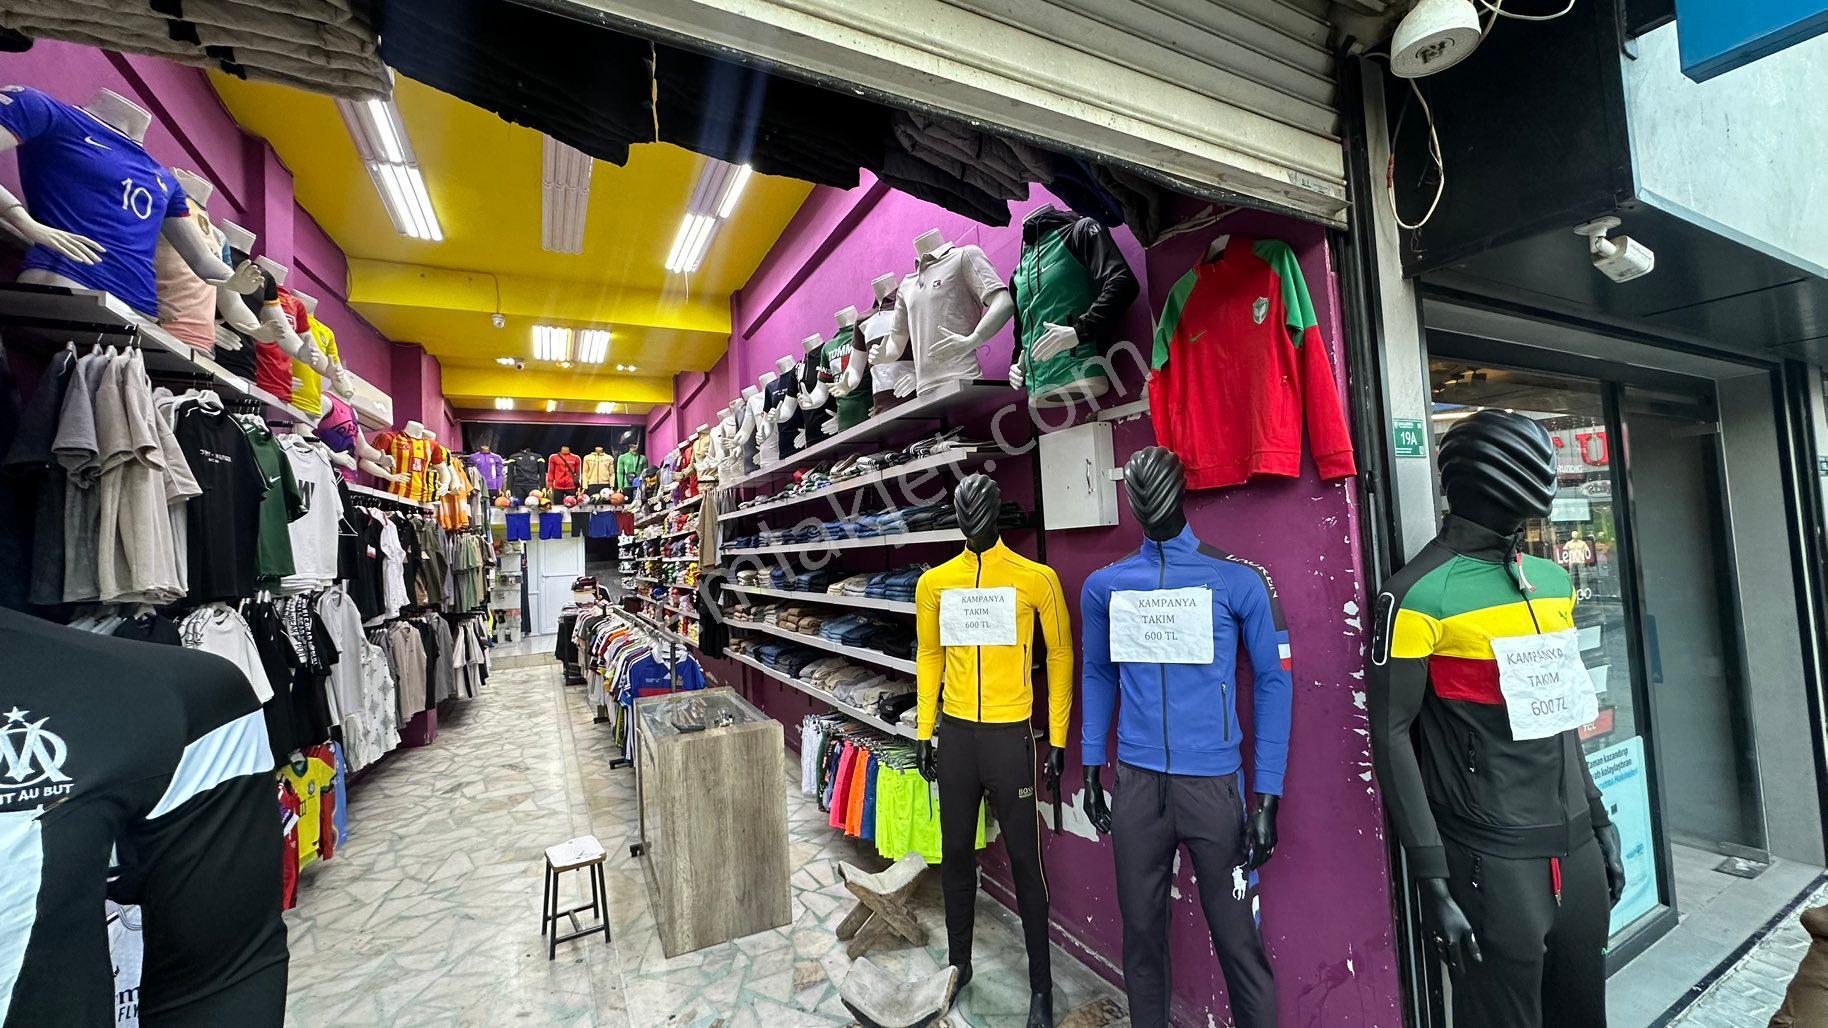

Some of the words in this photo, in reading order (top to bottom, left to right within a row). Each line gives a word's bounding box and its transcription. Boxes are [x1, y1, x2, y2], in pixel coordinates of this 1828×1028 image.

[121, 178, 152, 219] 10
[1400, 431, 1418, 446] 19A
[1556, 465, 1583, 473] RUNDIG
[961, 595, 1005, 604] KAMPANYA
[1139, 598, 1197, 608] KAMPANYA
[964, 608, 989, 616] TAKIM
[1141, 615, 1176, 624] TAKIM
[1144, 632, 1163, 640] 600
[1165, 631, 1178, 640] TL
[1506, 647, 1564, 666] KAMPANYA
[1527, 672, 1560, 687] TAKIM
[1583, 723, 1597, 732] TCL
[18, 787, 40, 801] AU
[43, 783, 75, 797] BUT
